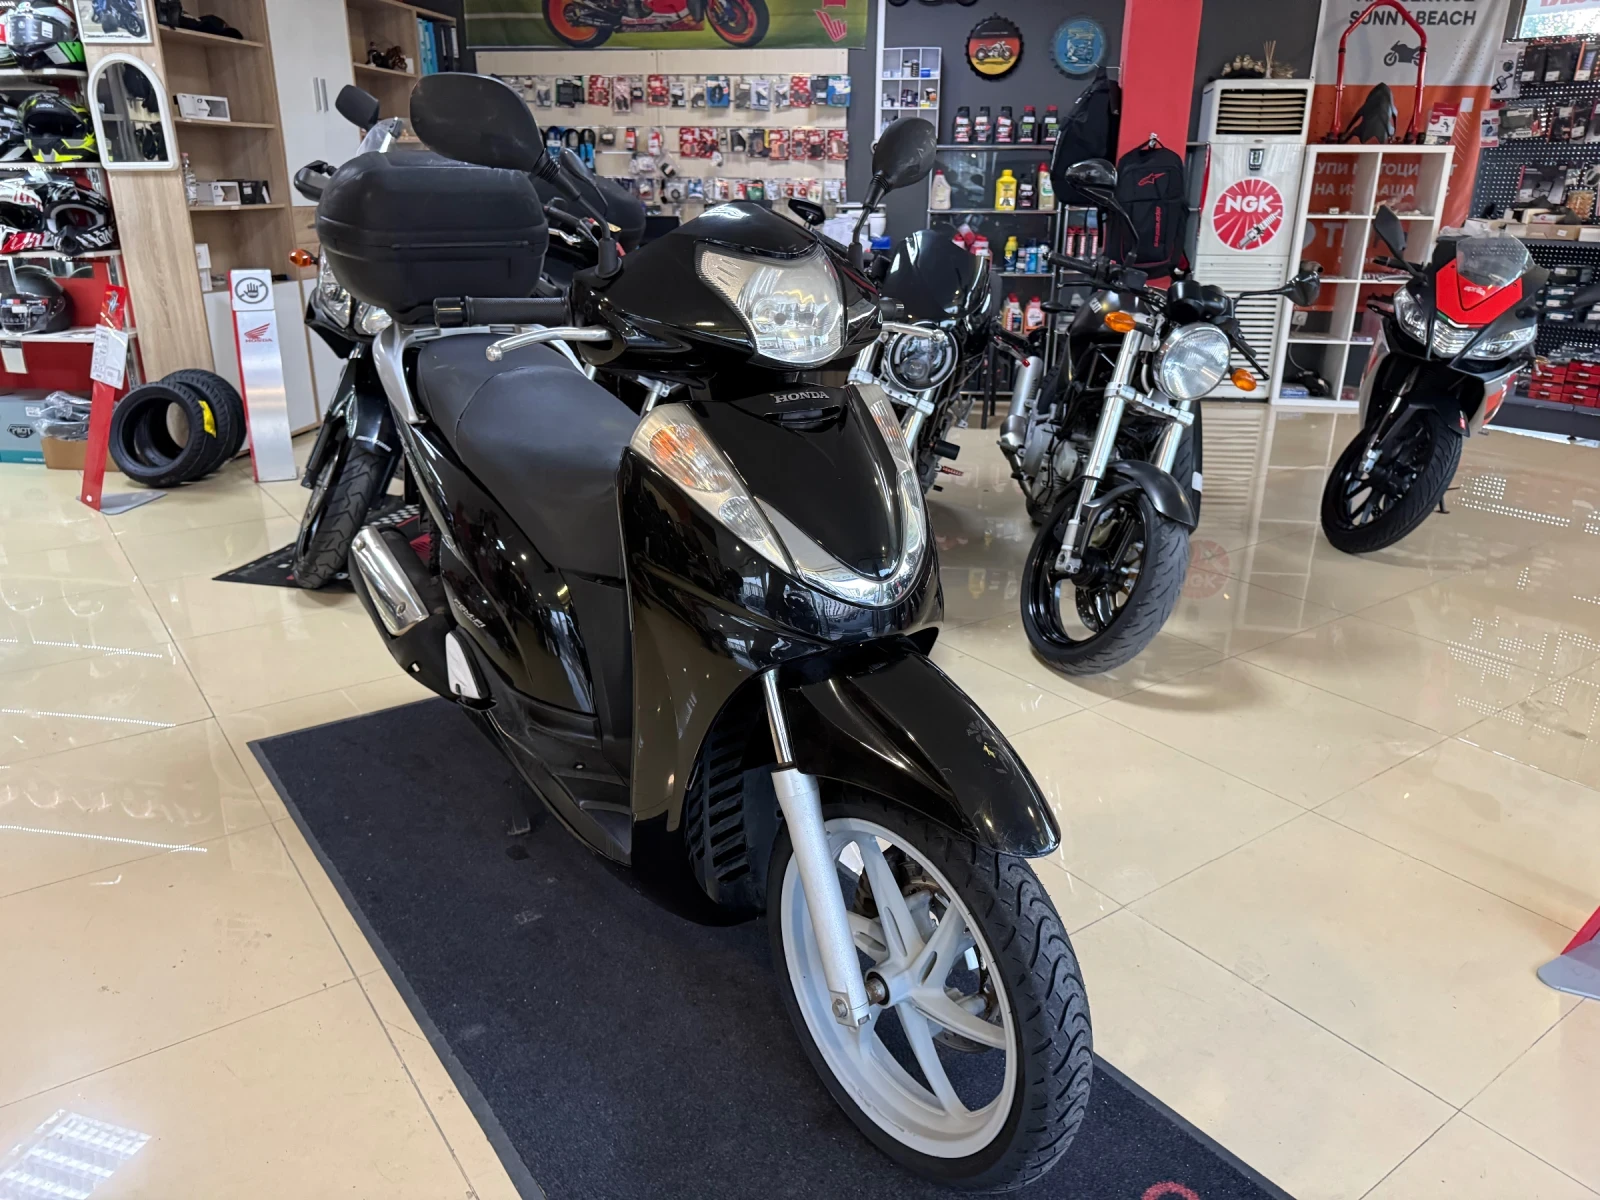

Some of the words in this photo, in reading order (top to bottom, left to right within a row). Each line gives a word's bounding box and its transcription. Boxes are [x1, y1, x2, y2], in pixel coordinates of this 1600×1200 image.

[1415, 10, 1477, 26] BEACH
[1314, 162, 1349, 175] УПИ
[1225, 195, 1275, 213] NGK
[1463, 286, 1486, 296] aprilia
[774, 391, 830, 403] HONDA
